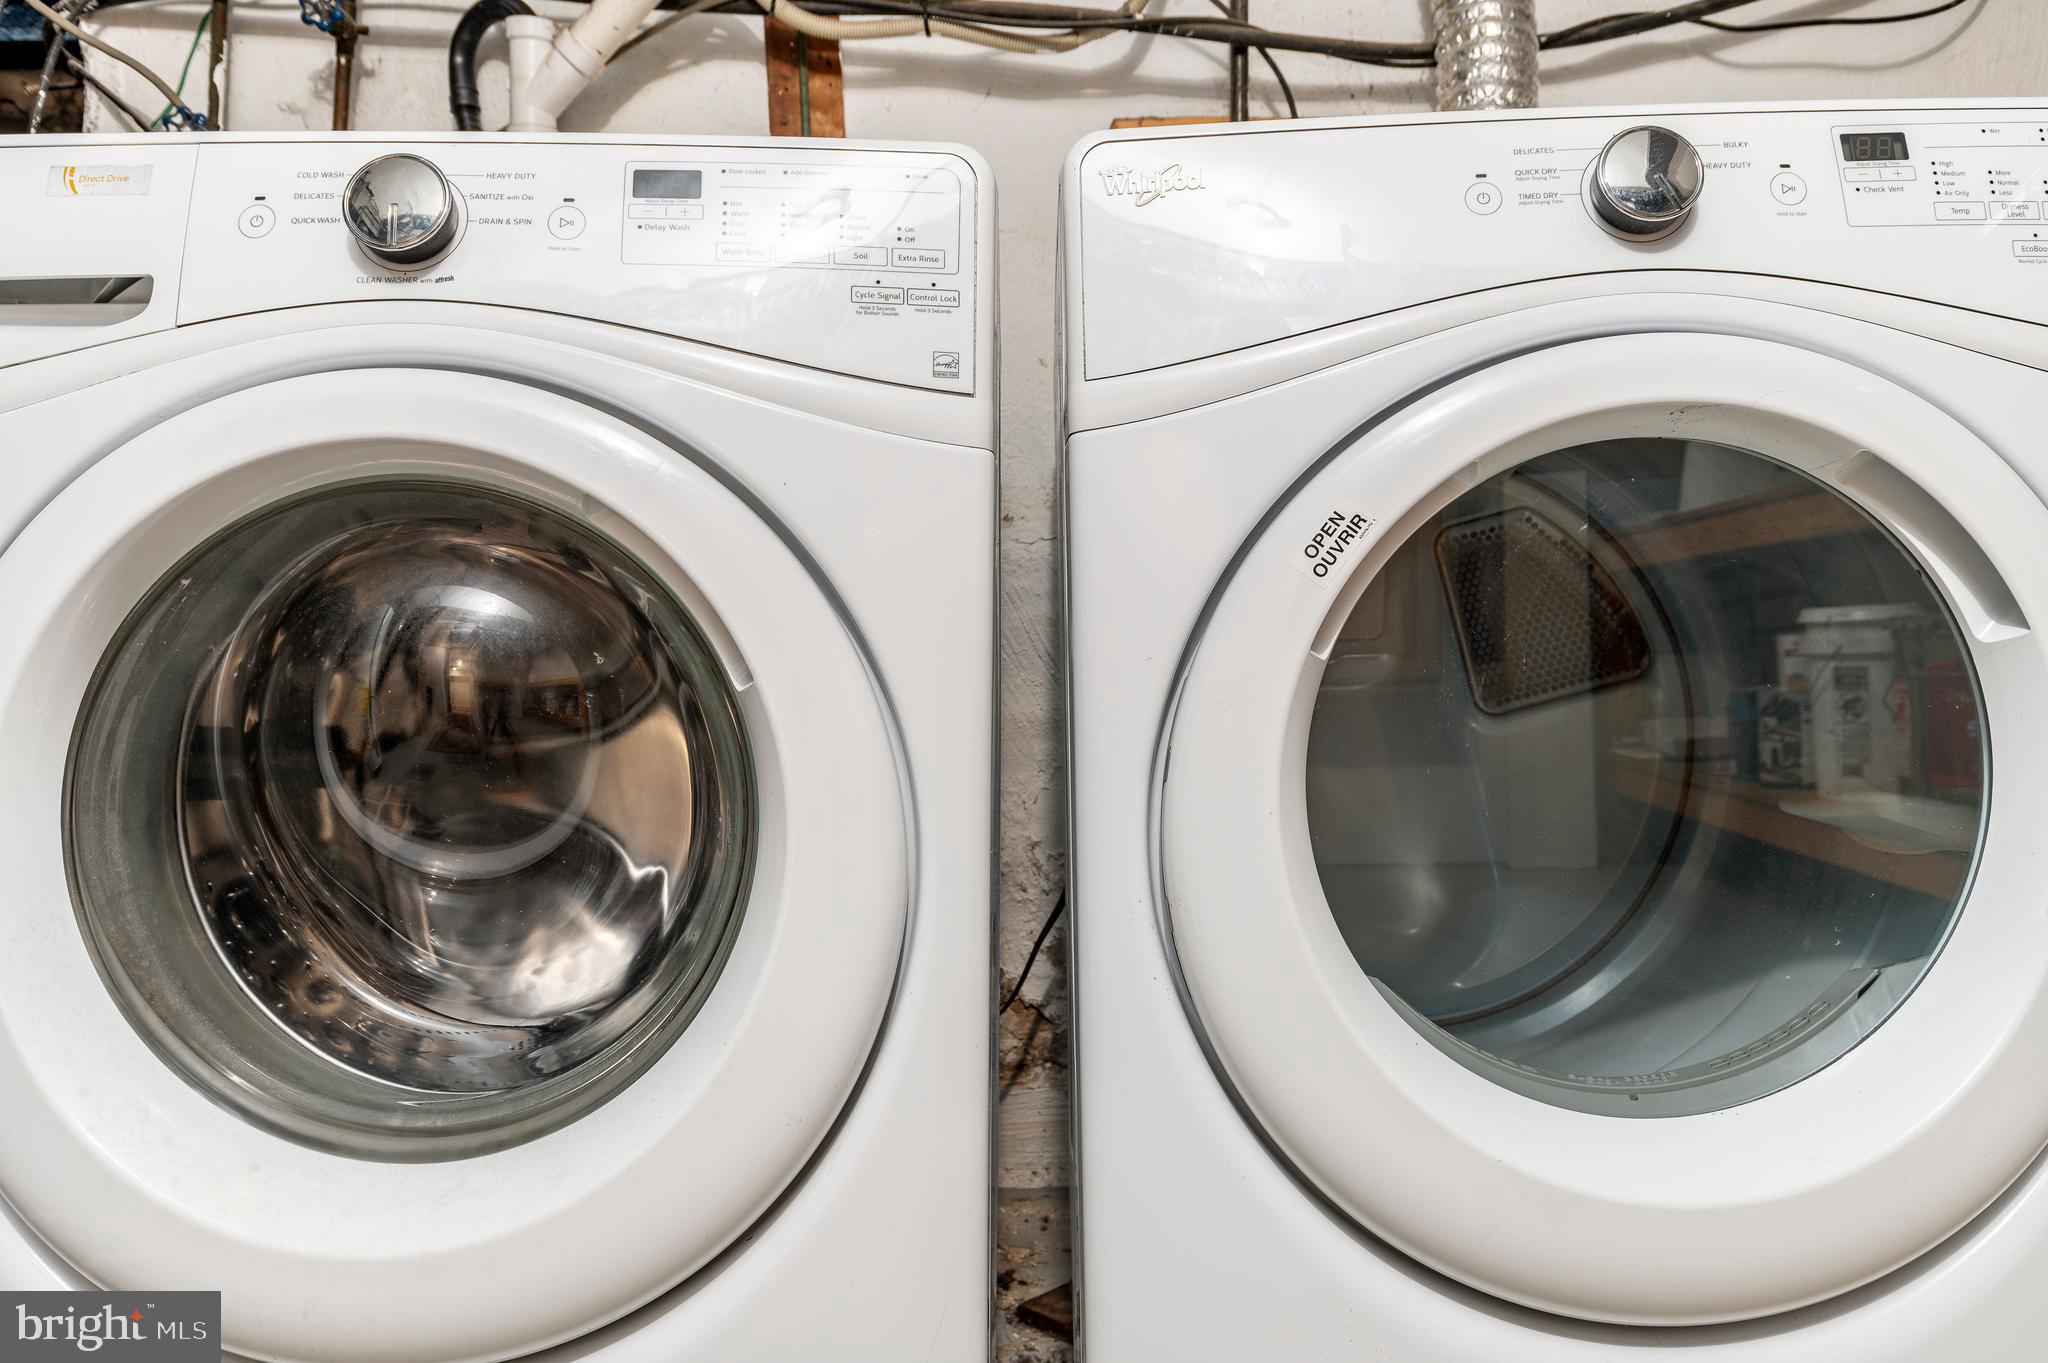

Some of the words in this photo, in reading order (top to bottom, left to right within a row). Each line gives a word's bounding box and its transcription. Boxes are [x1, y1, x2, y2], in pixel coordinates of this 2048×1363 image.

[1513, 147, 1554, 156] DELICATES
[486, 172, 512, 180] HEAVY
[514, 172, 536, 180] DUTY
[1514, 168, 1540, 176] QUICK
[79, 174, 104, 182] Direct
[106, 174, 129, 182] Drive
[1099, 162, 1206, 204] Whirlpool
[293, 192, 335, 200] DELICATES
[469, 192, 504, 200] SANITIZE
[1952, 207, 1970, 215] Temp
[290, 217, 316, 226] QUICK
[316, 216, 341, 224] WASH
[644, 224, 666, 232] Delay
[2021, 244, 2048, 252] EcoBoo
[356, 276, 382, 284] CLEAN
[384, 276, 418, 284] WASHER
[434, 275, 454, 284] affresh
[854, 290, 876, 300] Cycle
[878, 292, 901, 301] Signal
[910, 294, 938, 302] Control
[940, 295, 958, 303] Lock
[1304, 510, 1346, 558] OPEN
[1313, 514, 1368, 578] OUVRIR
